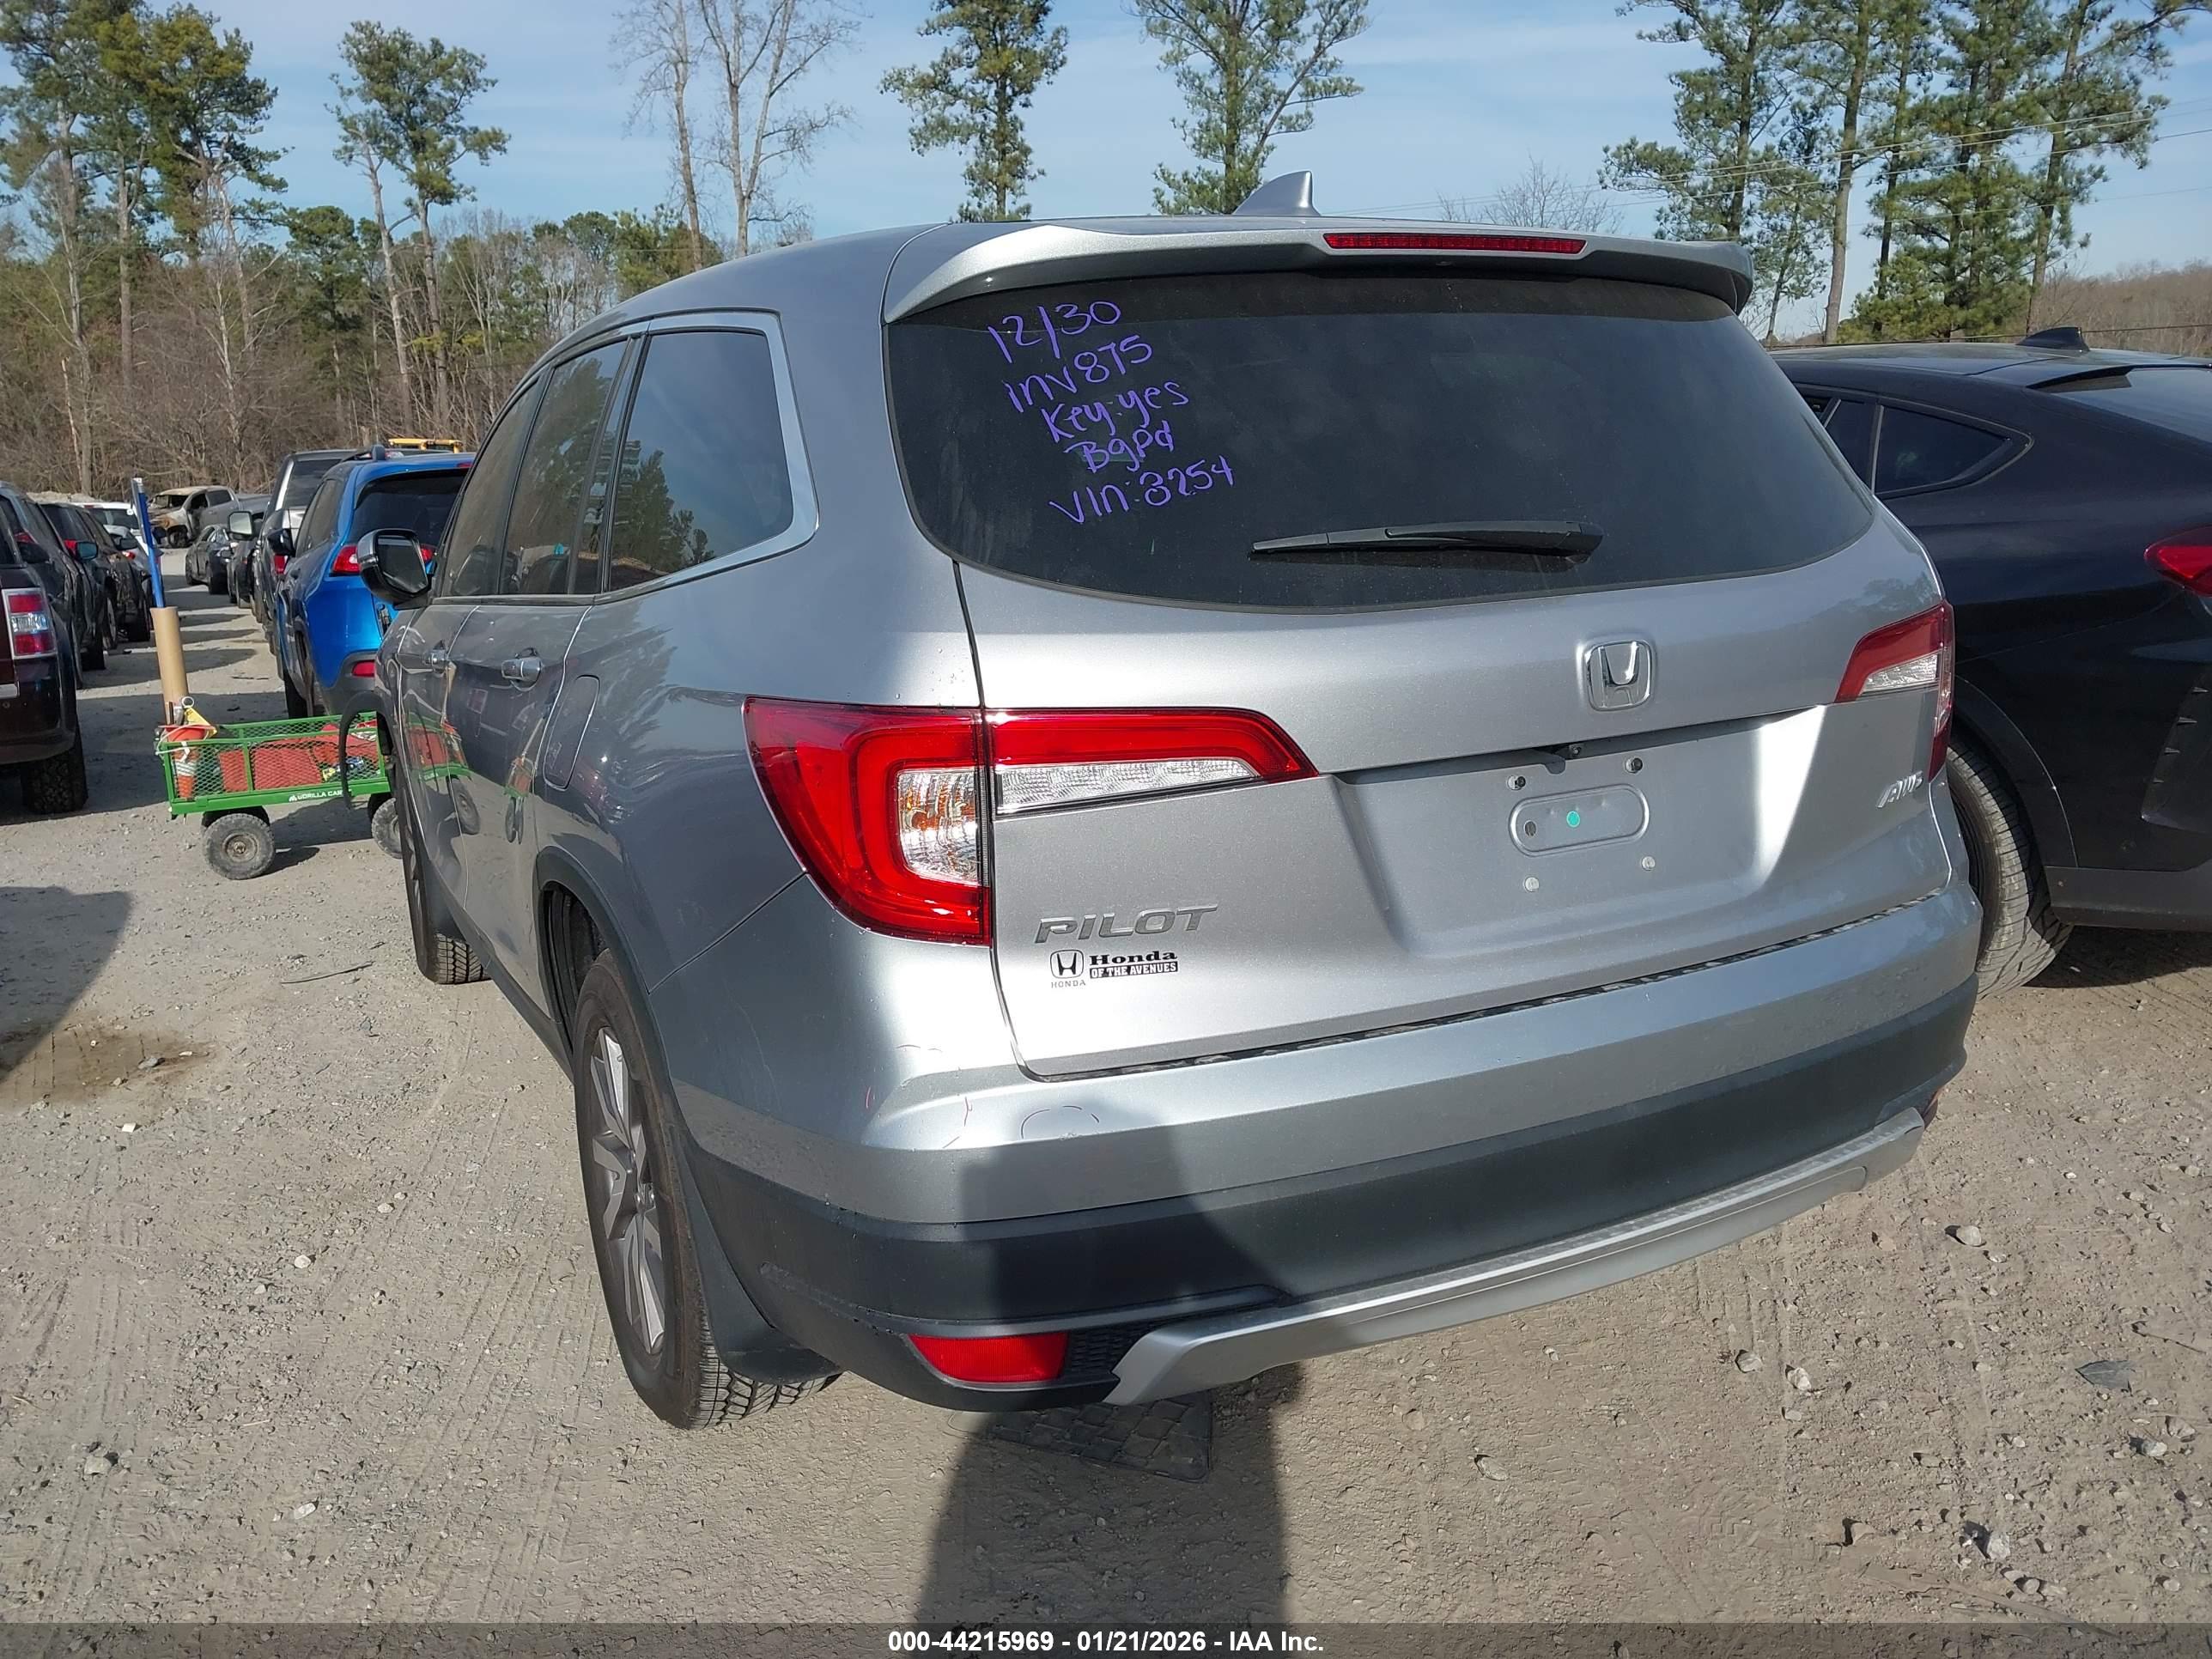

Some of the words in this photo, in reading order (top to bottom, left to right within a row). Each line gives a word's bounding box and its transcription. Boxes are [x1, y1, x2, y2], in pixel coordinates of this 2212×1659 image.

[988, 301, 1121, 363] 12/30
[1034, 904, 1218, 944] PILOT
[1089, 951, 1177, 965] Honda
[1091, 968, 1105, 977] OF
[1107, 966, 1127, 976] THE
[1129, 962, 1176, 975] AVENUES
[1051, 979, 1086, 988] HONDA
